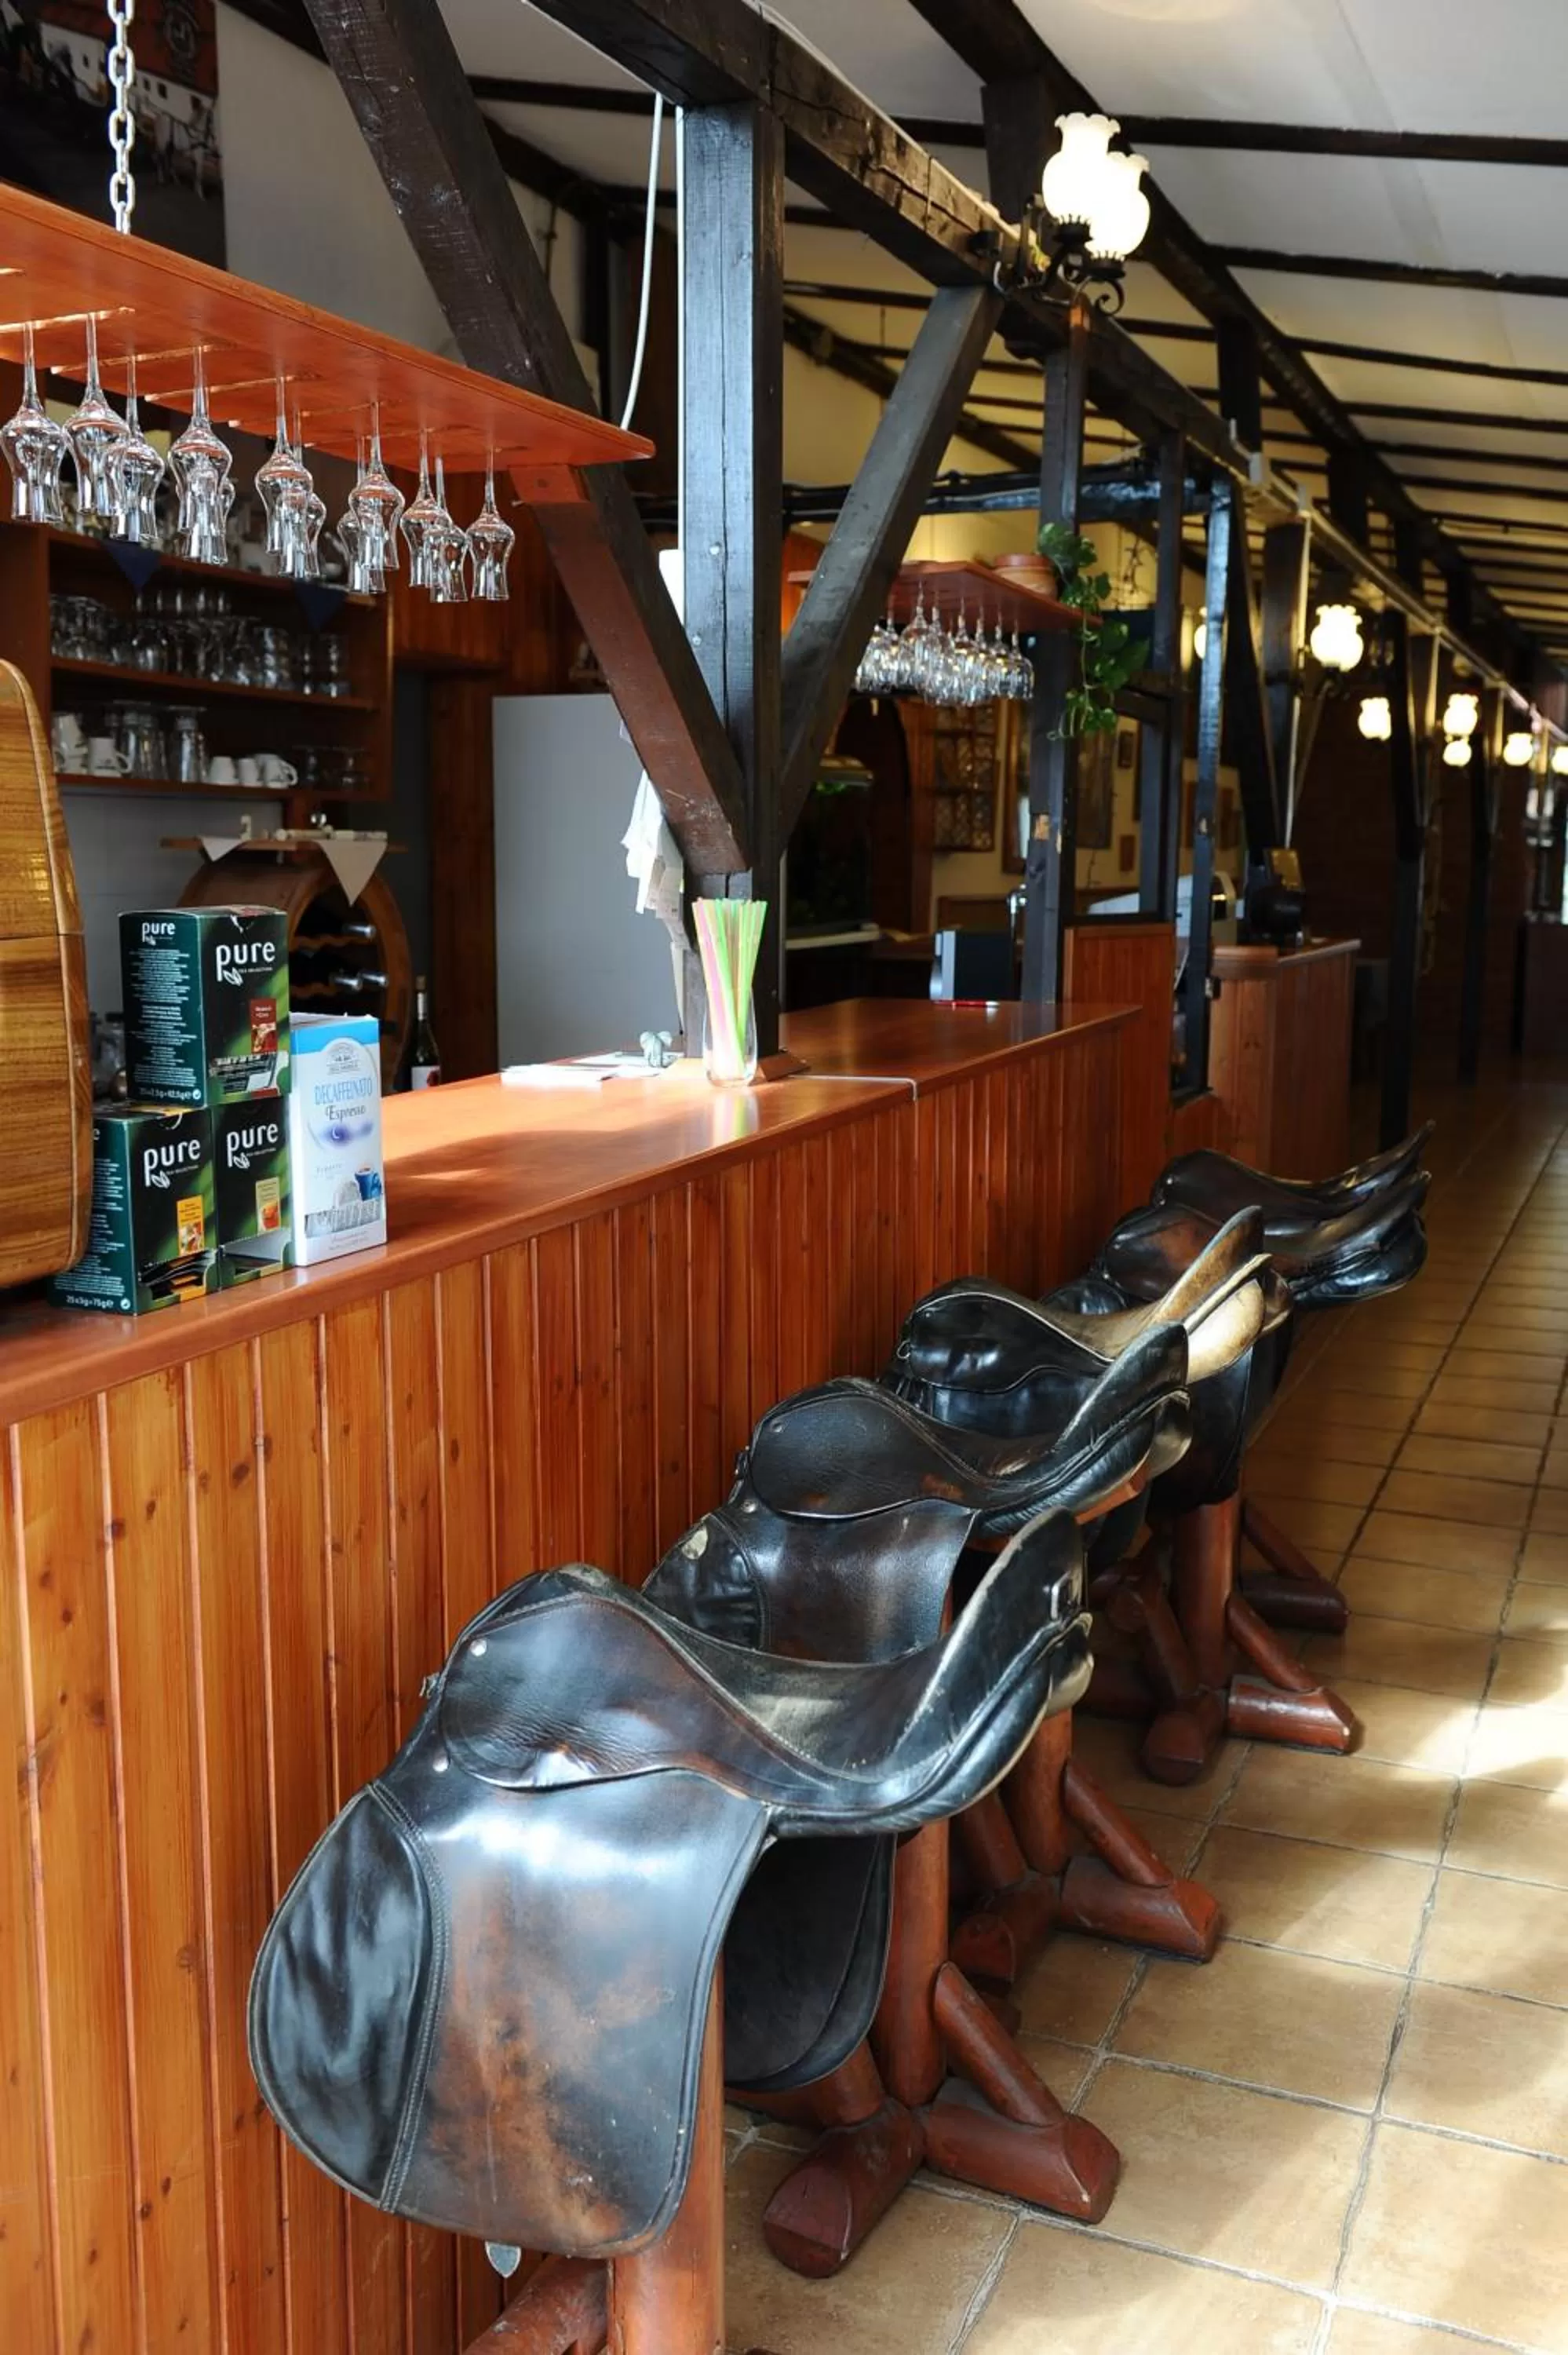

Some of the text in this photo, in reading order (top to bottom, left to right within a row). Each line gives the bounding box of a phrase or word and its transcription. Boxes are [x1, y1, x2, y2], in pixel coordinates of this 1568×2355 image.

[142, 922, 175, 942] pure
[216, 942, 275, 981] pure
[326, 1105, 366, 1123] Espresso
[144, 1139, 200, 1187] pure
[227, 1123, 279, 1167] pure
